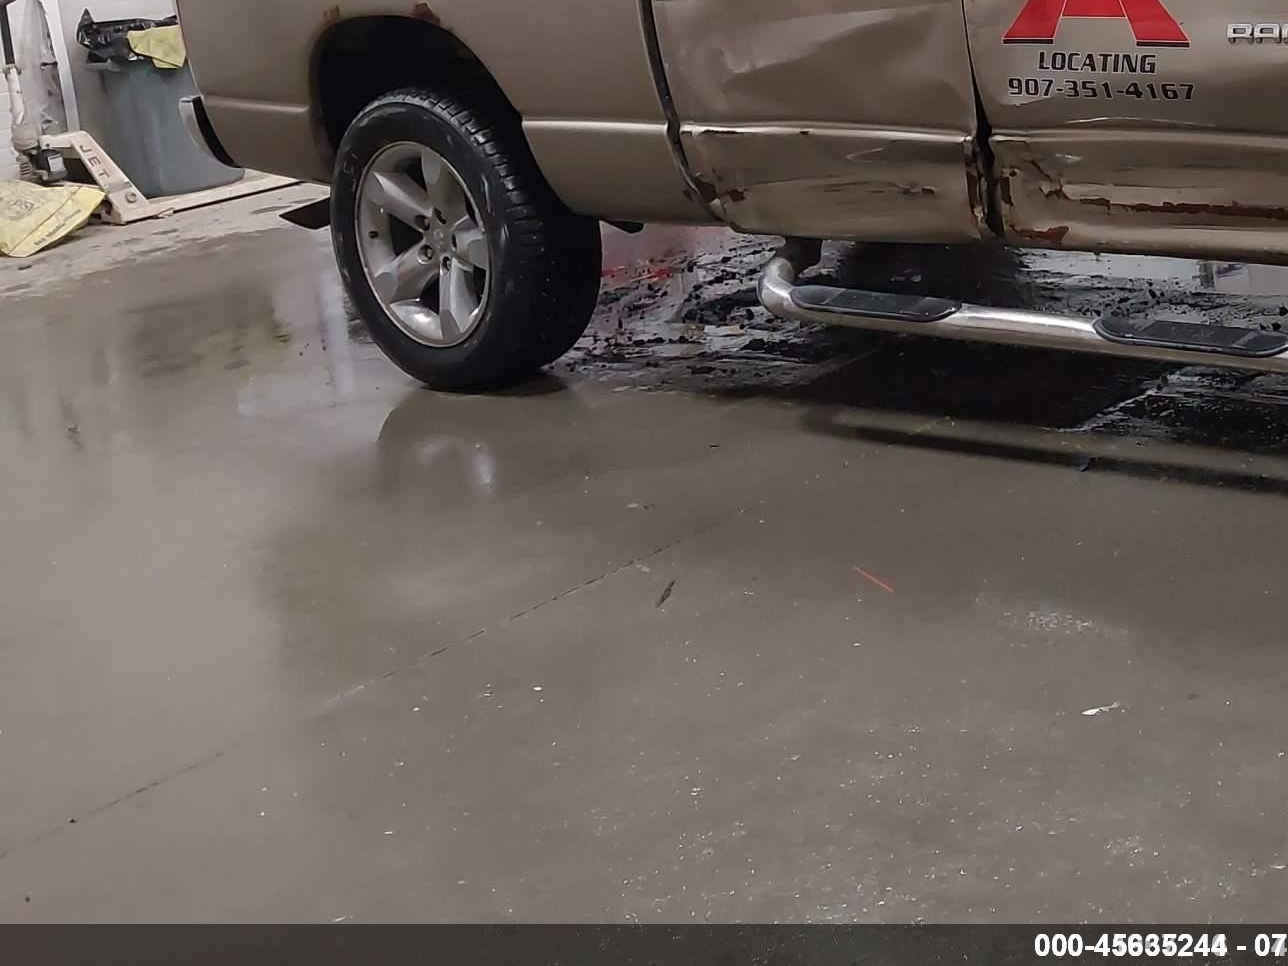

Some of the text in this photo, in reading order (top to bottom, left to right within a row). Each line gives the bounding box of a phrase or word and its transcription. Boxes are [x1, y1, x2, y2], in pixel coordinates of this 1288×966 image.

[1037, 51, 1157, 74] LOCATING
[1007, 77, 1195, 101] 907-351-4167
[80, 145, 111, 178] JET
